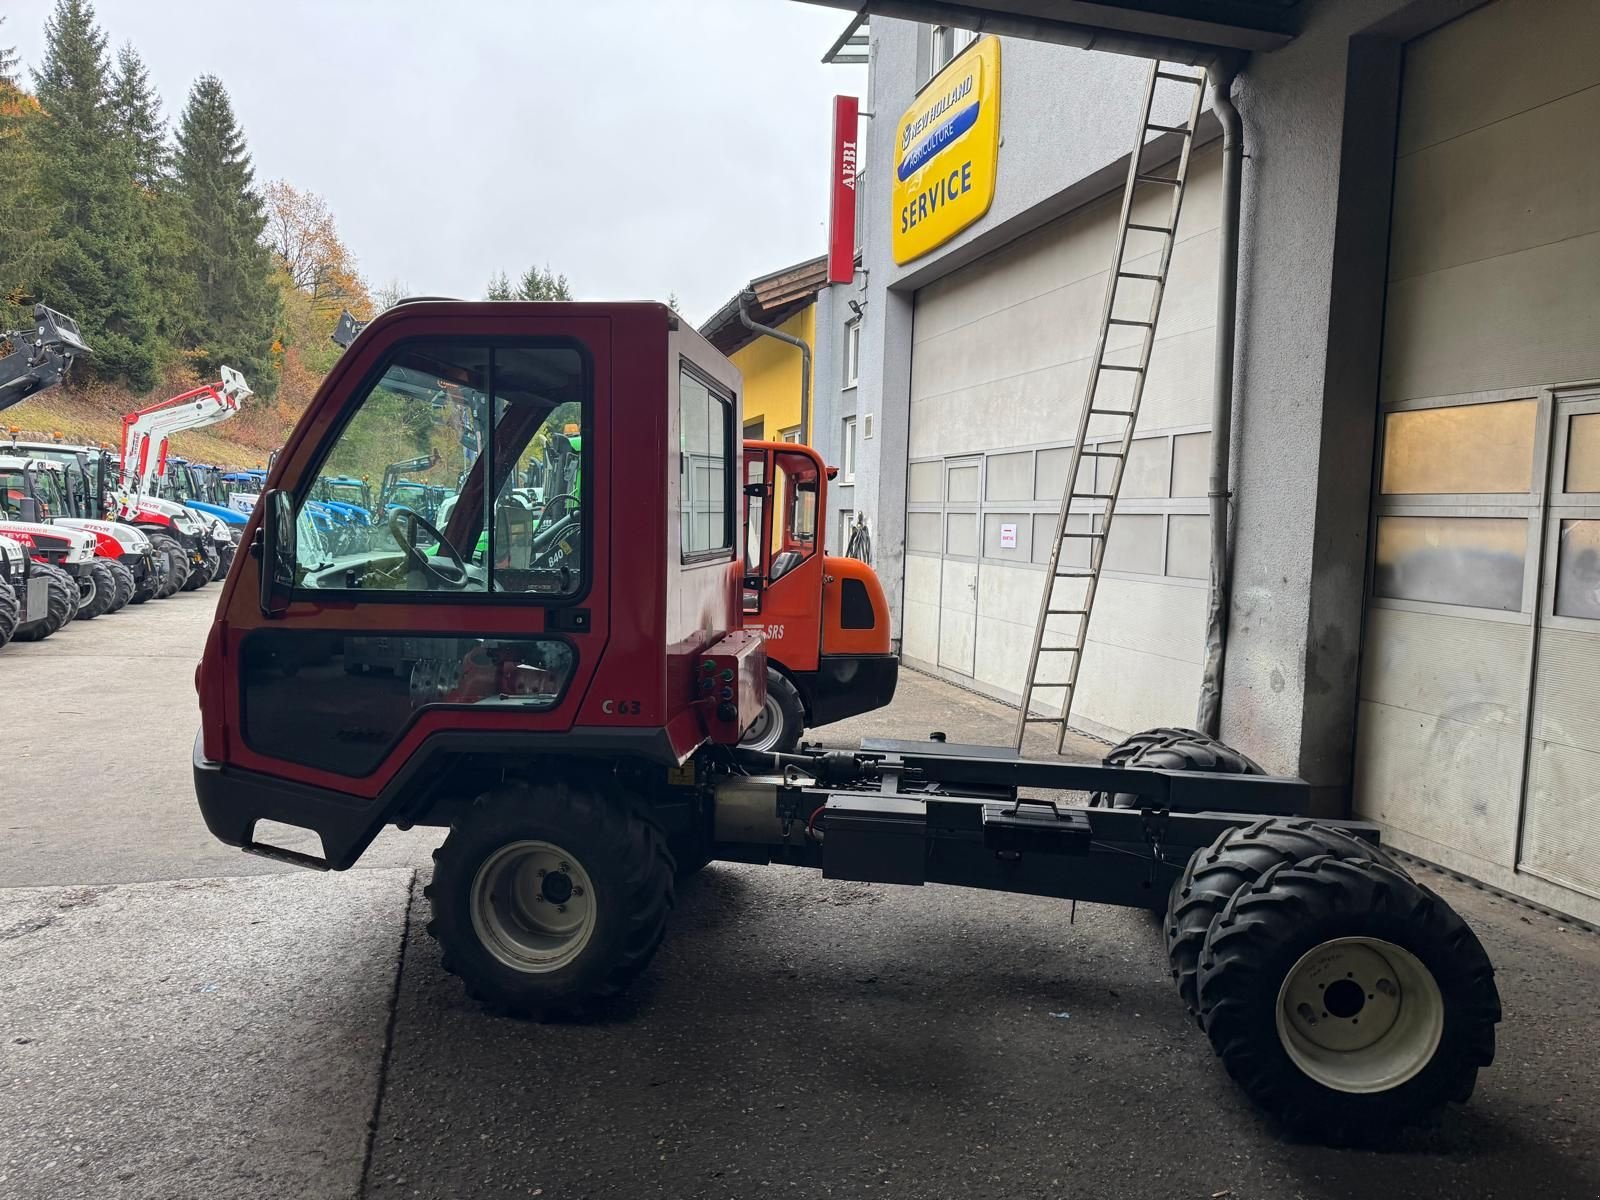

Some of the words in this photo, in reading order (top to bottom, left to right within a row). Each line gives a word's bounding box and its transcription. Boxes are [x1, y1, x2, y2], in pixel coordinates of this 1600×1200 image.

[911, 110, 929, 140] NEW
[930, 74, 972, 124] HOLLAND
[842, 141, 856, 190] AEBI
[909, 121, 954, 169] AGRICULTURE
[901, 160, 972, 234] SERVICE
[83, 524, 110, 532] STEYR
[767, 624, 785, 640] SRS
[602, 699, 614, 715] C
[617, 700, 641, 715] 63
